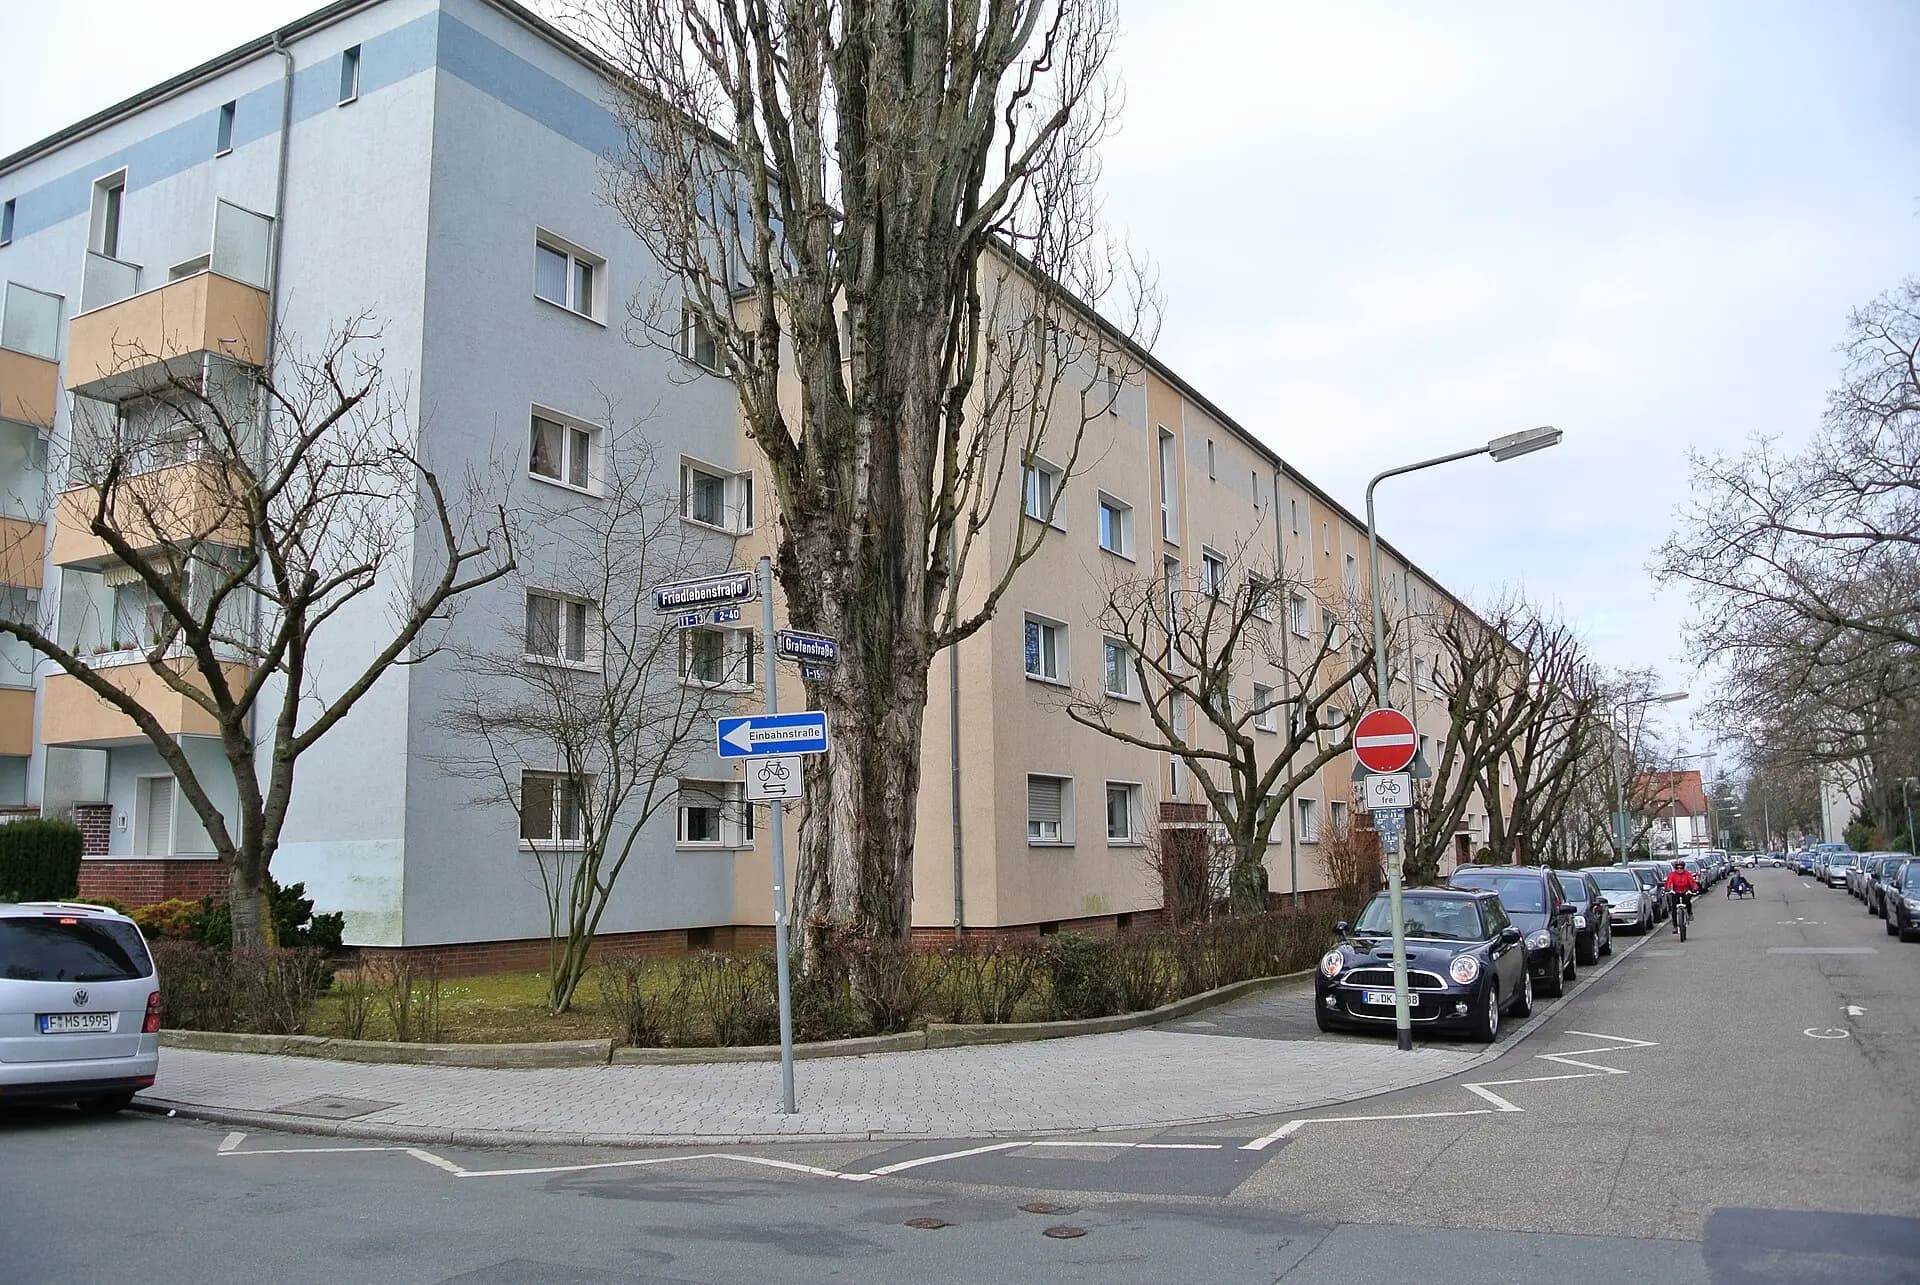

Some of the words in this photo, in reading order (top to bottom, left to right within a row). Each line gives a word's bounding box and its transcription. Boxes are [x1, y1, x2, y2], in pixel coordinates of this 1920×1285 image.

[662, 582, 743, 605] Friedlebenstraße
[680, 614, 704, 627] 11-13
[720, 609, 739, 621] 2-40
[749, 727, 820, 741] Einbahnstraße
[1382, 796, 1396, 804] frei
[65, 1015, 80, 1027] MS
[82, 1014, 109, 1027] 1995
